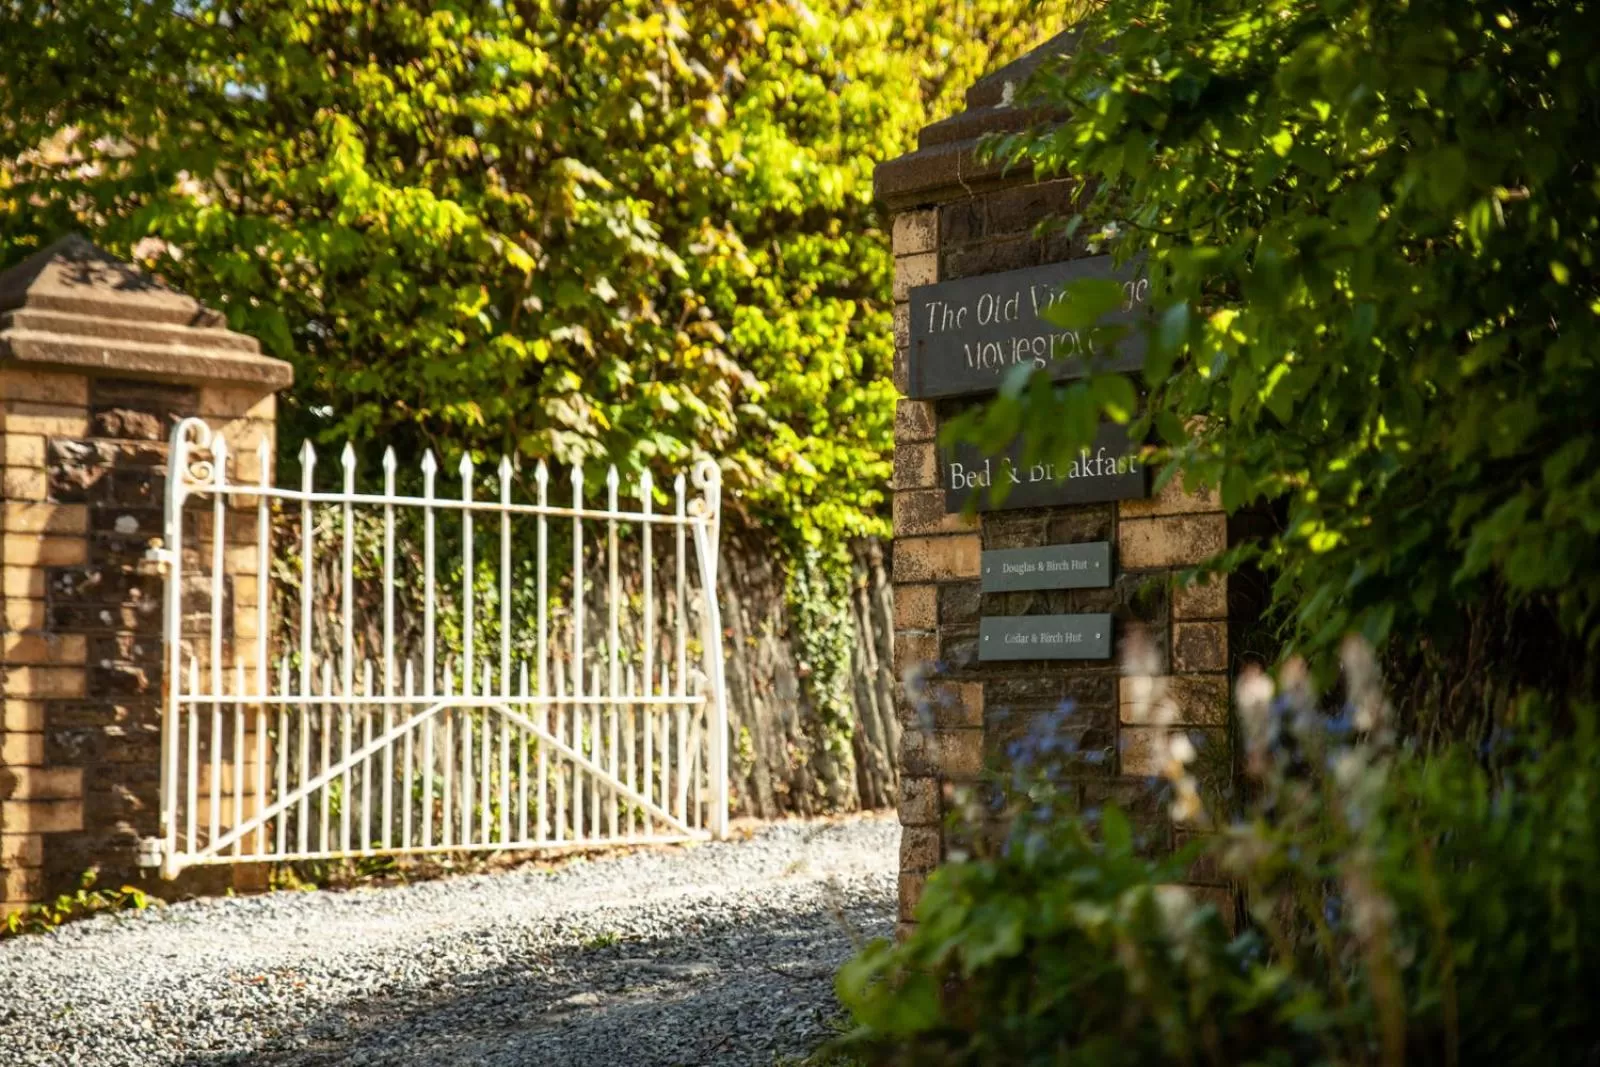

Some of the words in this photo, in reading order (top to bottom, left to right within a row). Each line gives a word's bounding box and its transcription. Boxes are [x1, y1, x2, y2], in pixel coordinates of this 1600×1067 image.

[925, 301, 967, 333] The
[976, 291, 1020, 326] Old
[1030, 278, 1149, 318] Vicge
[950, 458, 992, 490] Bed
[1028, 447, 1138, 483] Brakfast
[1002, 561, 1036, 576] Douglas
[1038, 560, 1045, 572] &
[1046, 560, 1070, 572] Birch
[1071, 559, 1088, 571] Hut
[1031, 633, 1038, 644] &
[1040, 632, 1063, 644] Birch
[1065, 632, 1083, 644] Hut
